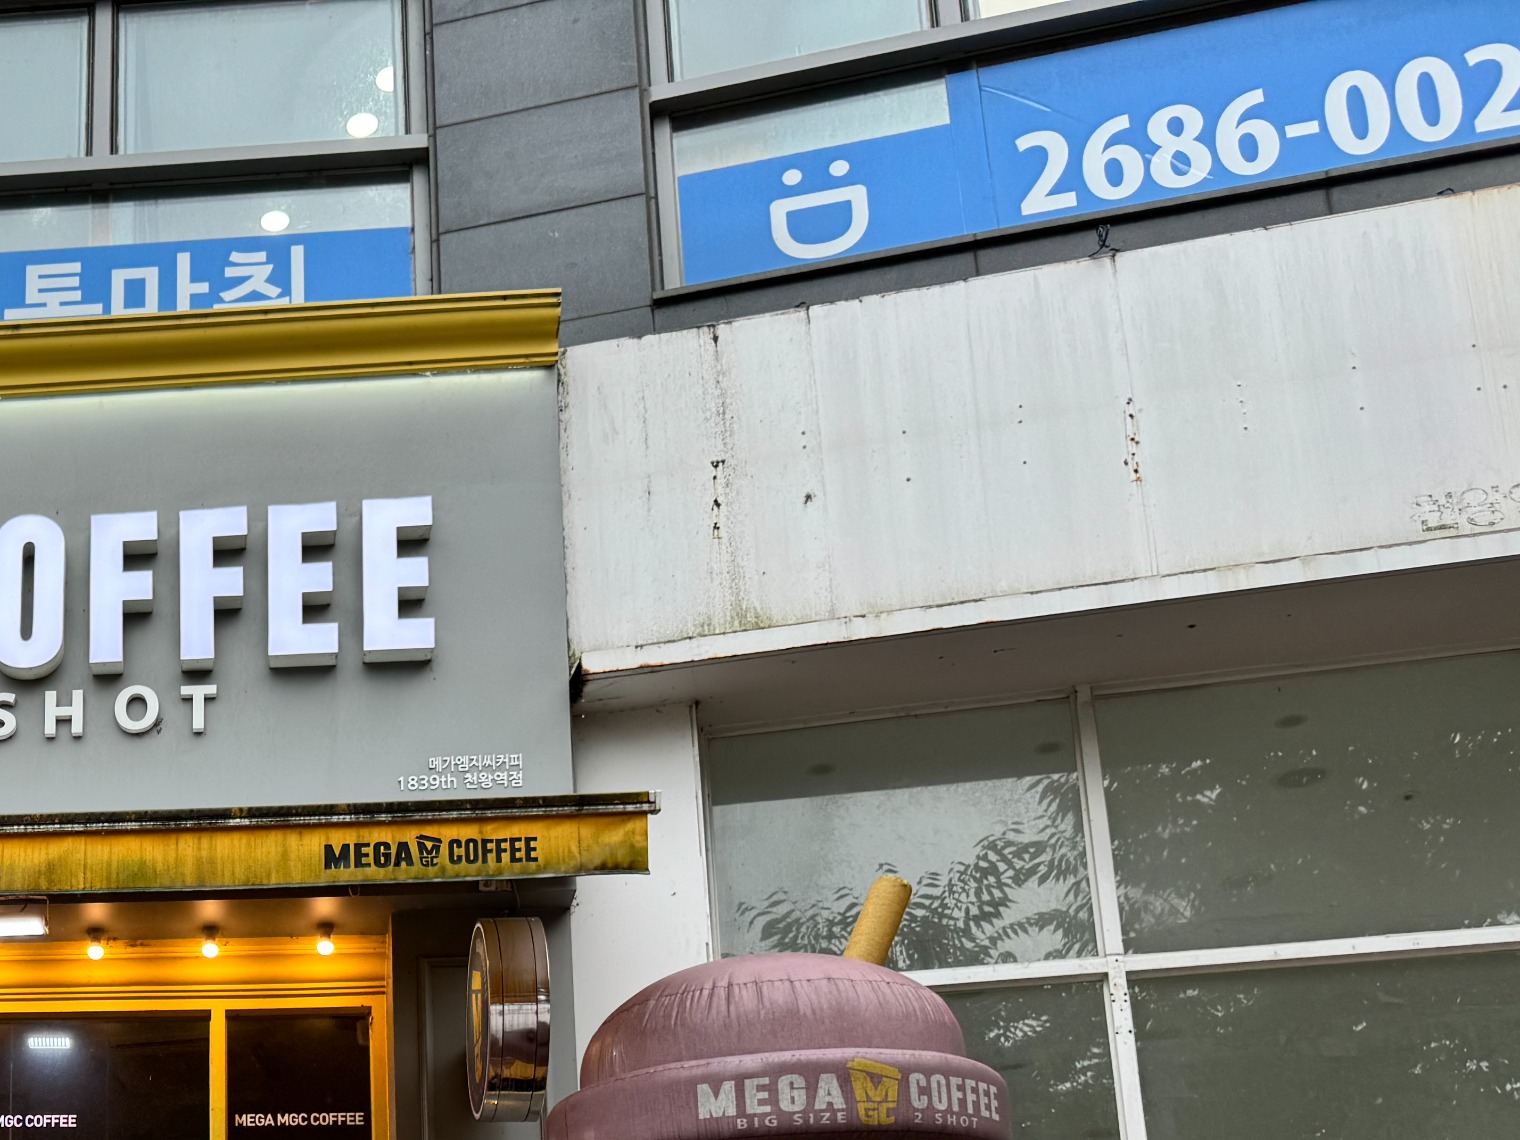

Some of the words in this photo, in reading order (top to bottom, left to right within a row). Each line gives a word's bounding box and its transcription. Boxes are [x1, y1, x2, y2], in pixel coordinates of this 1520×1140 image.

[1015, 43, 1520, 216] 2686-002
[428, 753, 523, 773] 메가엠지씨커피
[397, 774, 457, 791] 1839th
[463, 770, 523, 790] 천왕역점
[324, 841, 414, 870] MEGA
[448, 836, 538, 866] COFFEE
[696, 1072, 847, 1120] MEGA
[908, 1071, 1000, 1122] COFFEE
[24, 1115, 77, 1127] COFFEE
[235, 1114, 275, 1127] MEGA
[277, 1113, 308, 1126] MGC
[310, 1113, 365, 1126] COFFEE
[736, 1115, 778, 1130] BIG
[793, 1111, 848, 1126] SIZE
[913, 1112, 924, 1124] 2
[934, 1113, 979, 1129] SHOT
